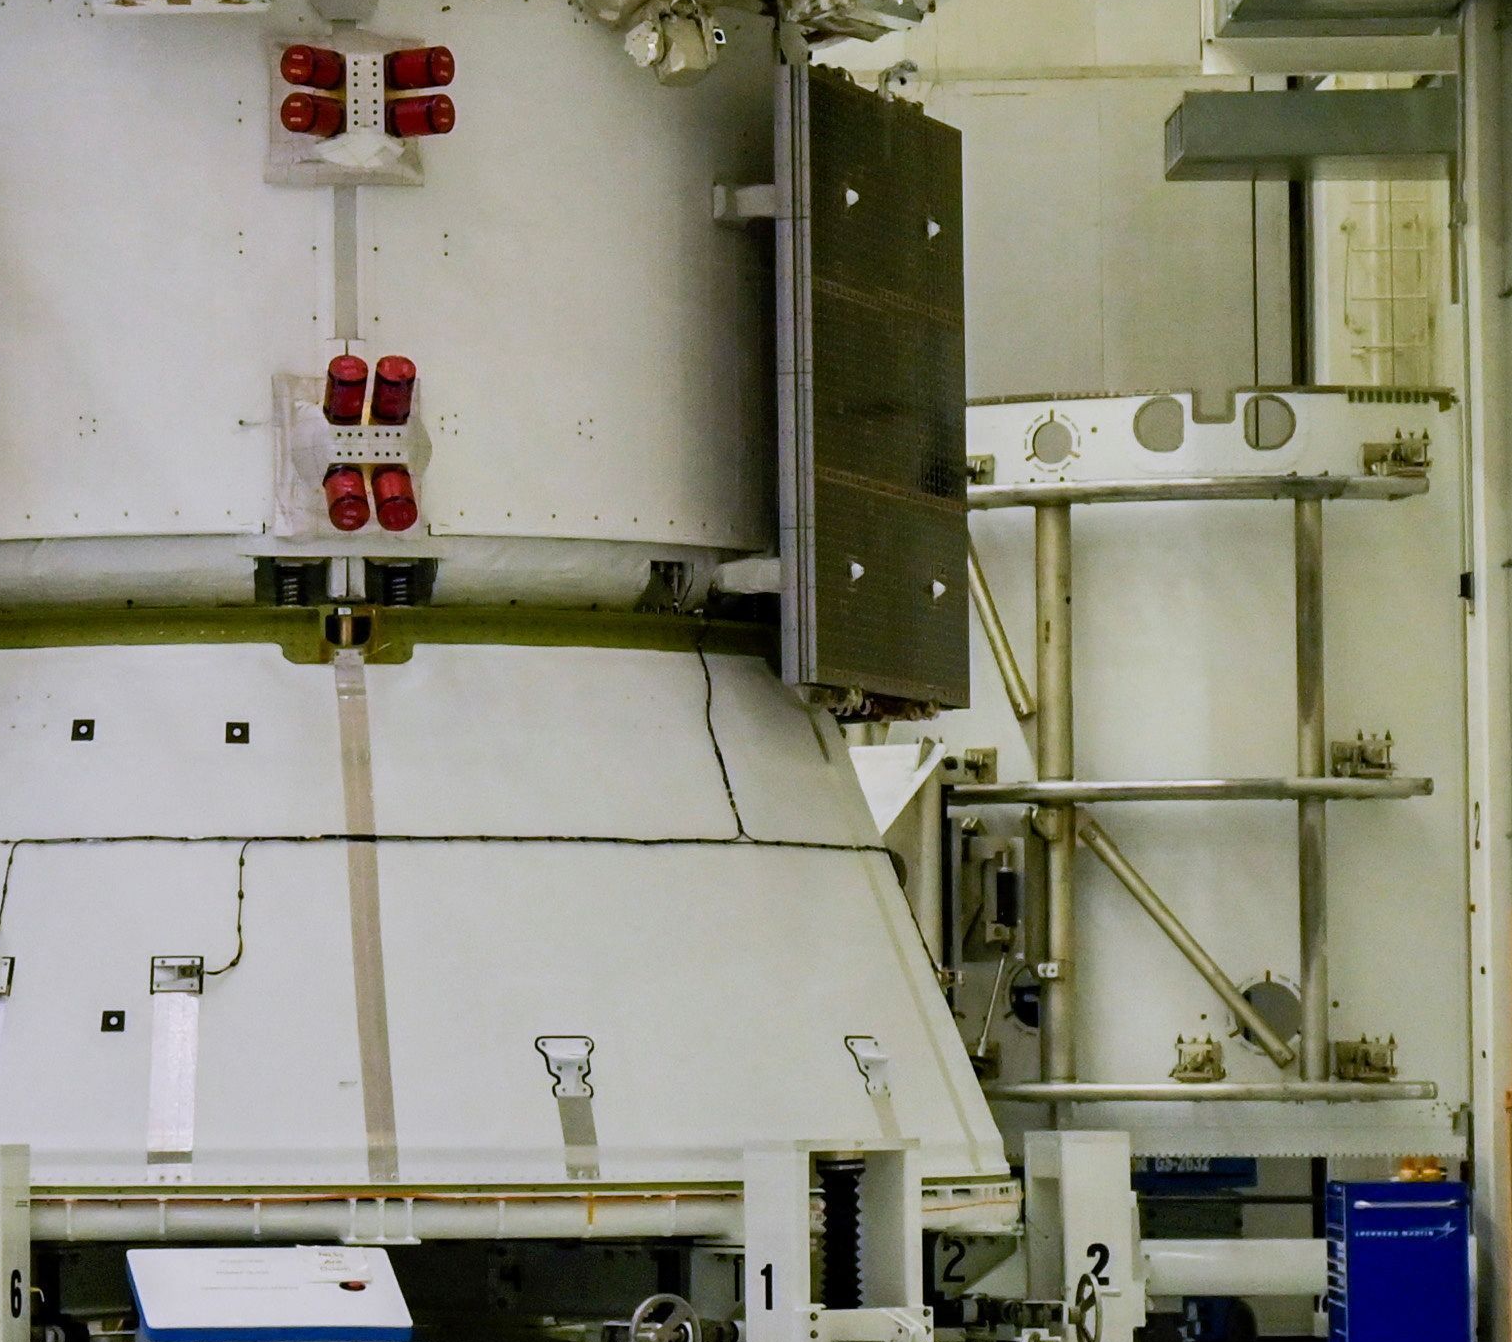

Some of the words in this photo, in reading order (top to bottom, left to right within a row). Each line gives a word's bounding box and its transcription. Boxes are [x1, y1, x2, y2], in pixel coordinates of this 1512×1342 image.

[943, 1240, 966, 1283] 2
[1086, 1243, 1110, 1286] 2
[10, 1269, 22, 1319] 6
[760, 1263, 773, 1310] 1
